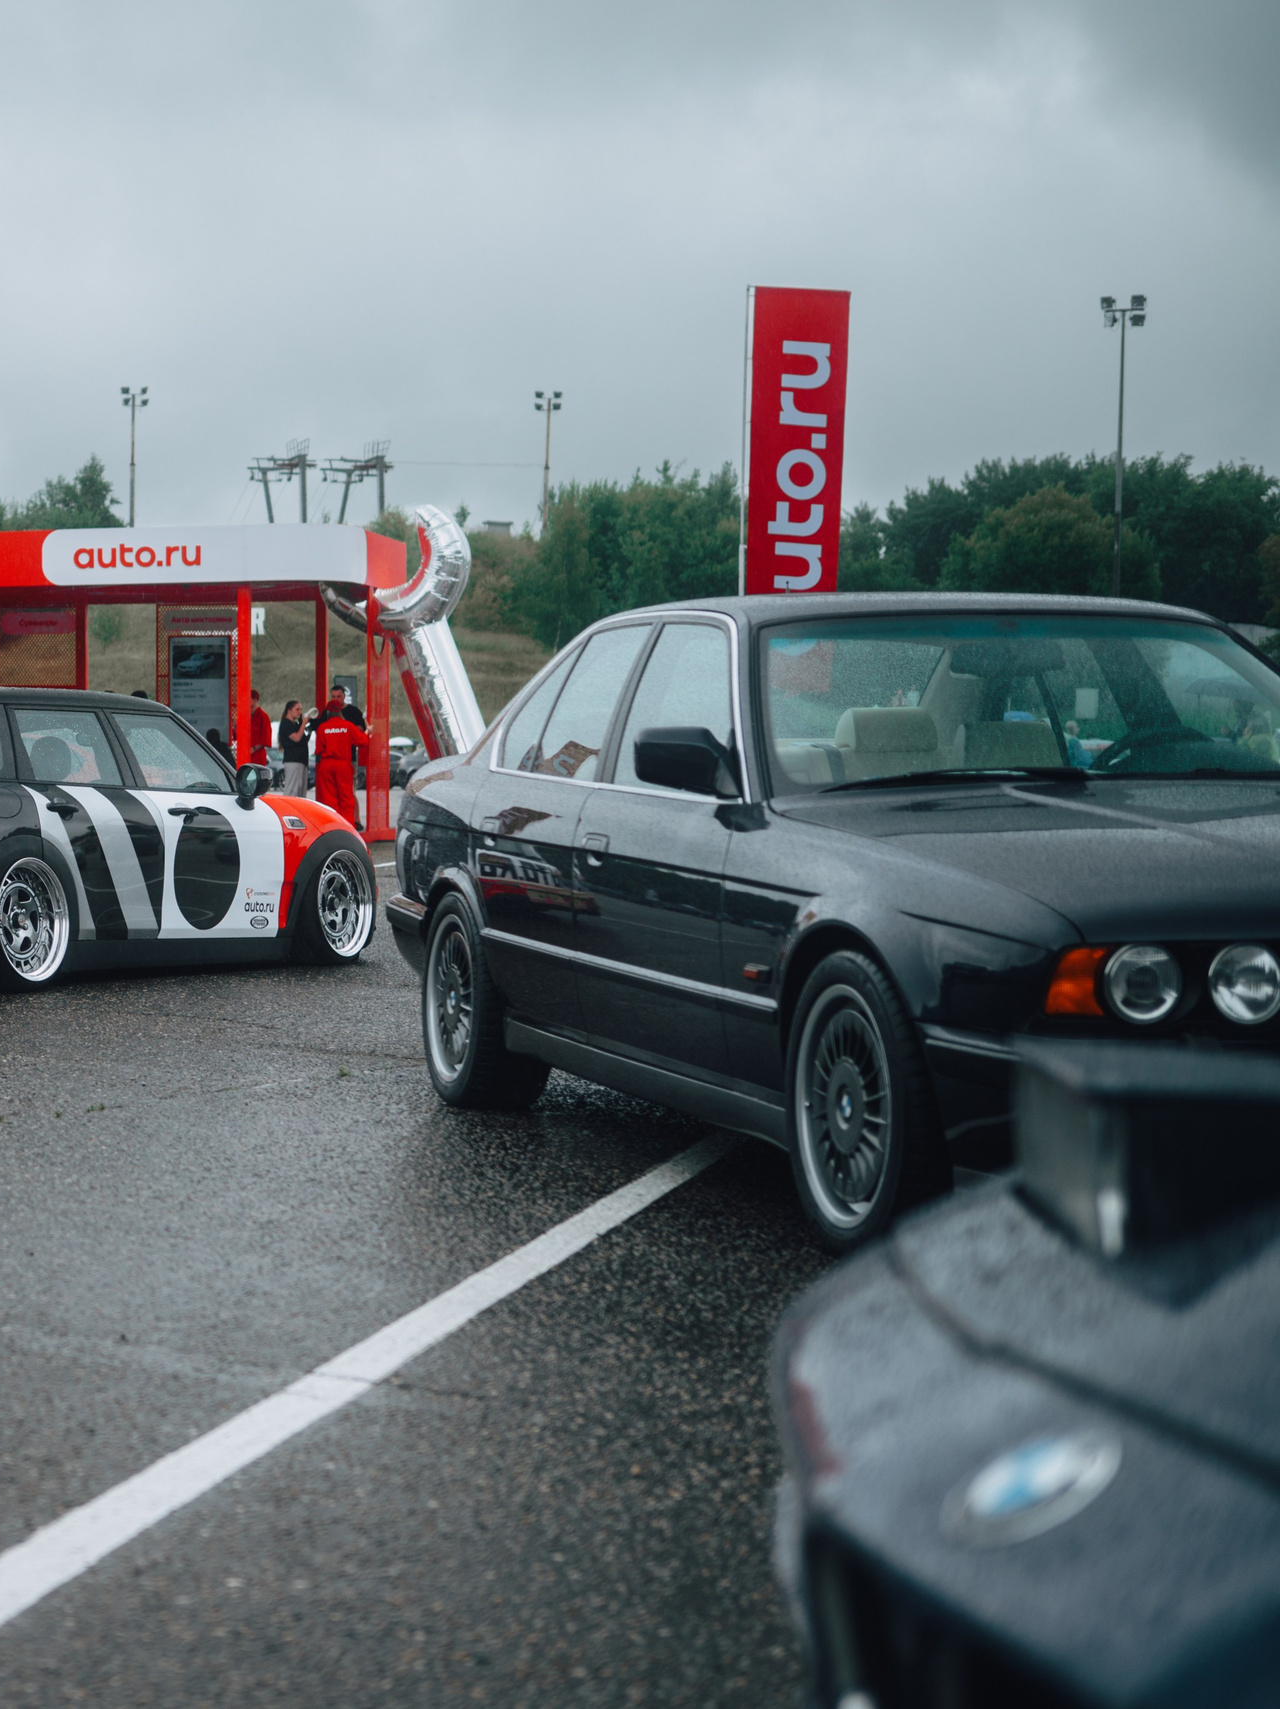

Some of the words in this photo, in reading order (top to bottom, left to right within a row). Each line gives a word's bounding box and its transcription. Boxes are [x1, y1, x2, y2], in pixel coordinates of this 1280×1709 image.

[767, 340, 831, 591] uto.ru
[73, 543, 201, 569] auto.ru
[244, 901, 274, 913] auto.ru
